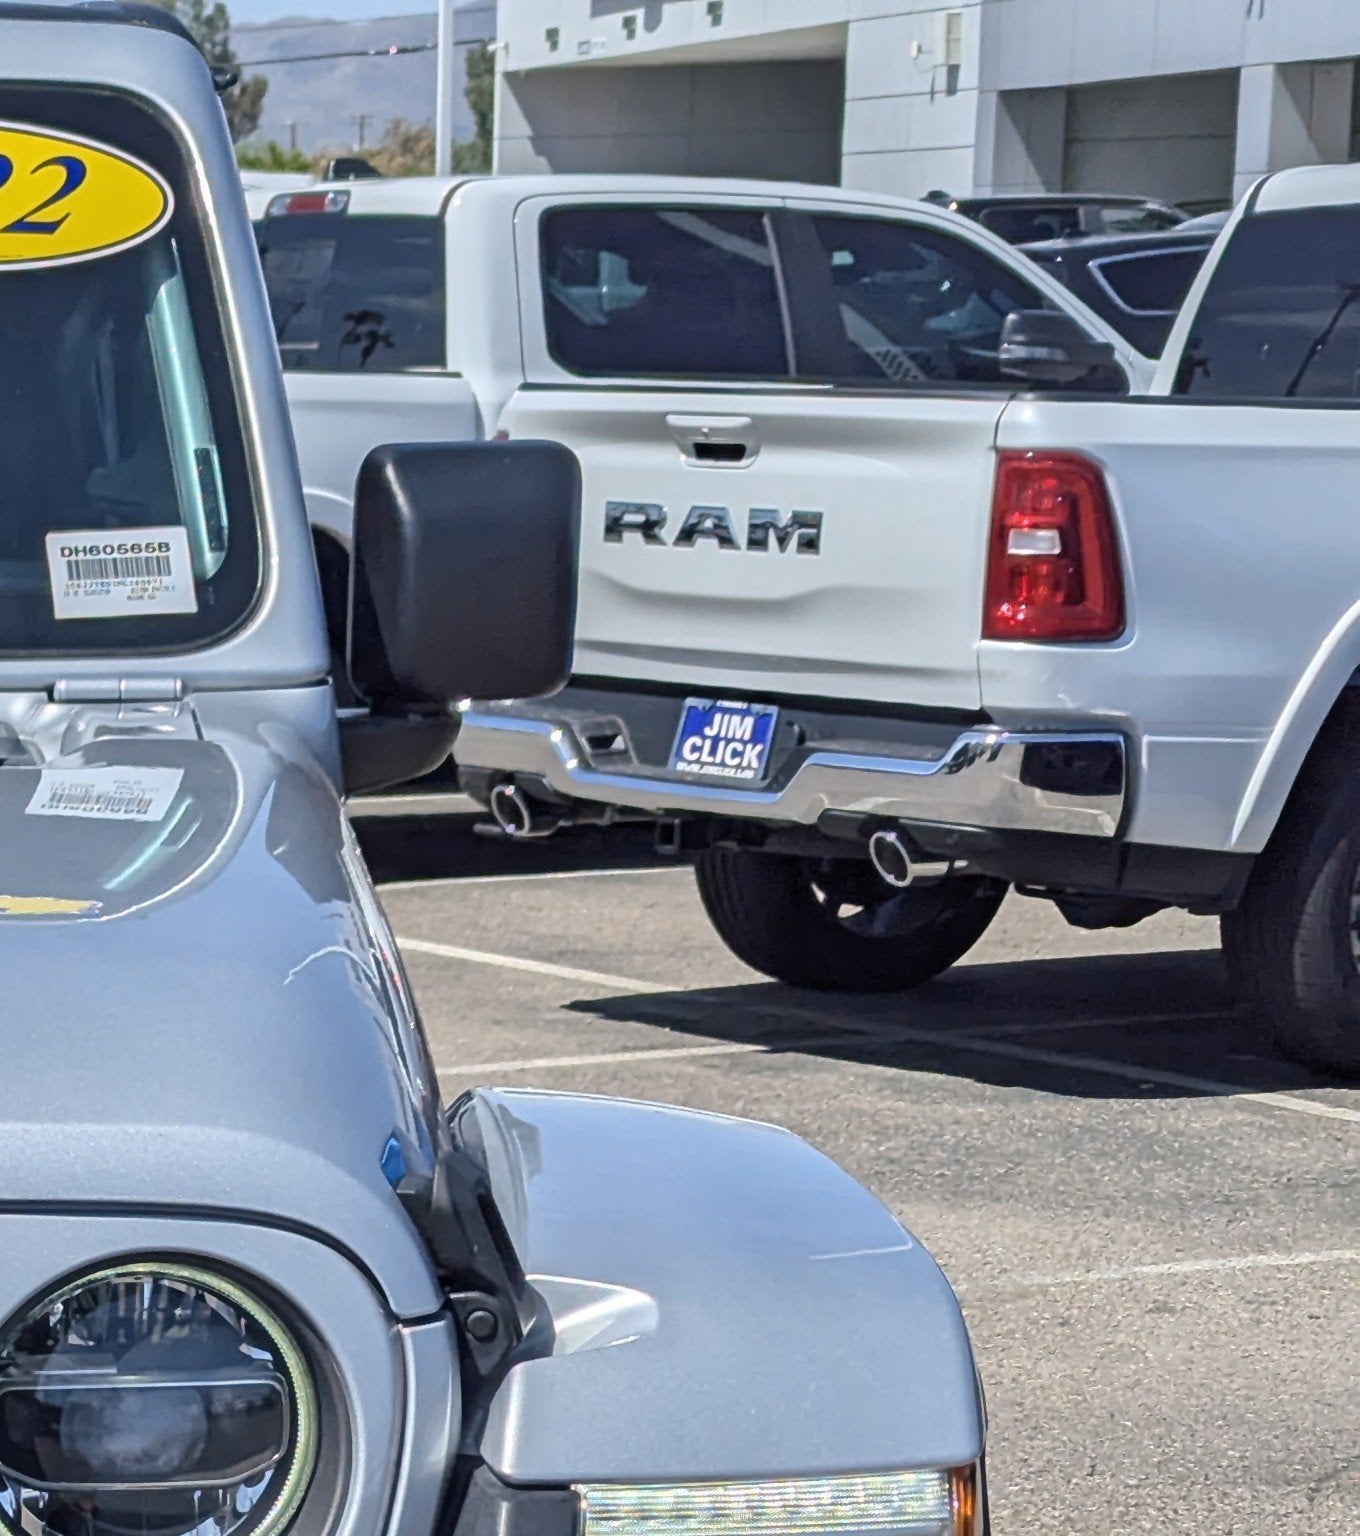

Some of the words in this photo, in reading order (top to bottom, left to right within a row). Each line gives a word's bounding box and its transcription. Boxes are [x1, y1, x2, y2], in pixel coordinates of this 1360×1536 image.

[602, 501, 825, 556] RAM
[704, 712, 755, 741] JIM
[682, 735, 764, 769] CLICK
